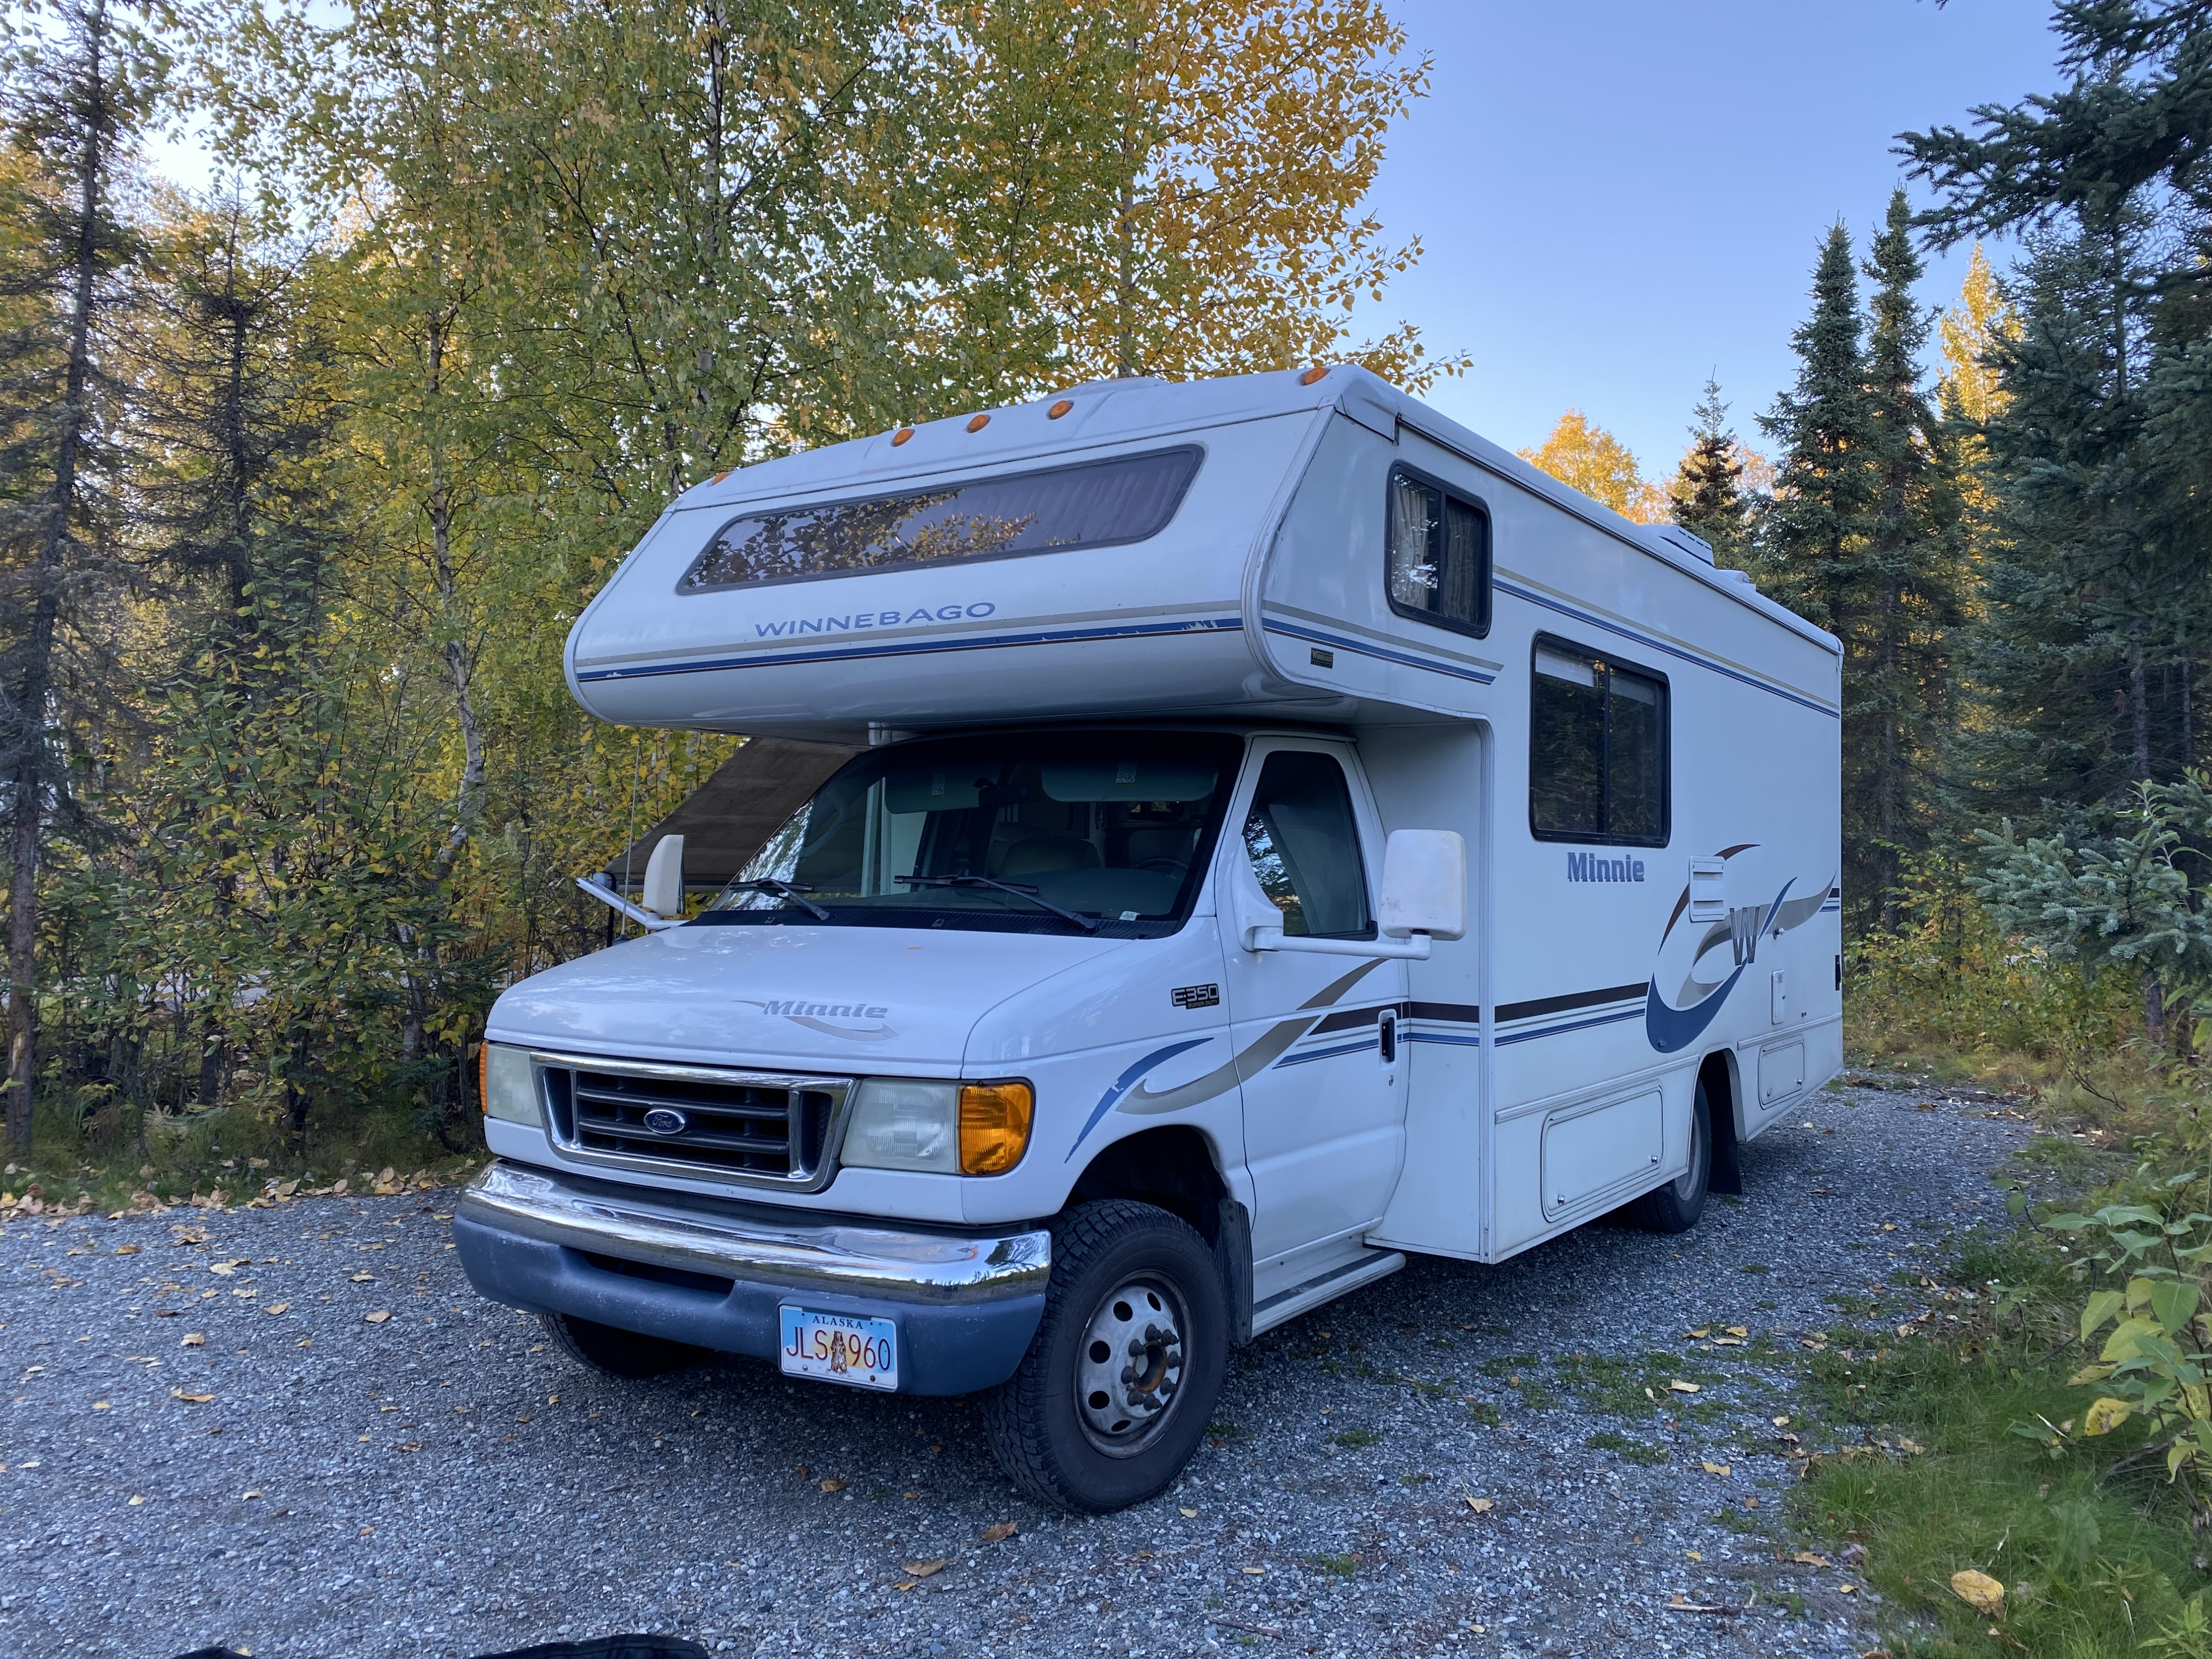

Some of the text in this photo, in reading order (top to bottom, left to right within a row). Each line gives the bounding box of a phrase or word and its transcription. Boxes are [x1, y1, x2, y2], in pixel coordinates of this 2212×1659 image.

[755, 602, 996, 637] WINNEBAGO
[1567, 852, 1645, 883] Minnie
[1729, 906, 1761, 967] W
[762, 1000, 888, 1019] Minnie
[653, 1114, 674, 1128] Ford
[812, 1315, 864, 1330] ALASKA
[786, 1326, 891, 1371] JLS 960
